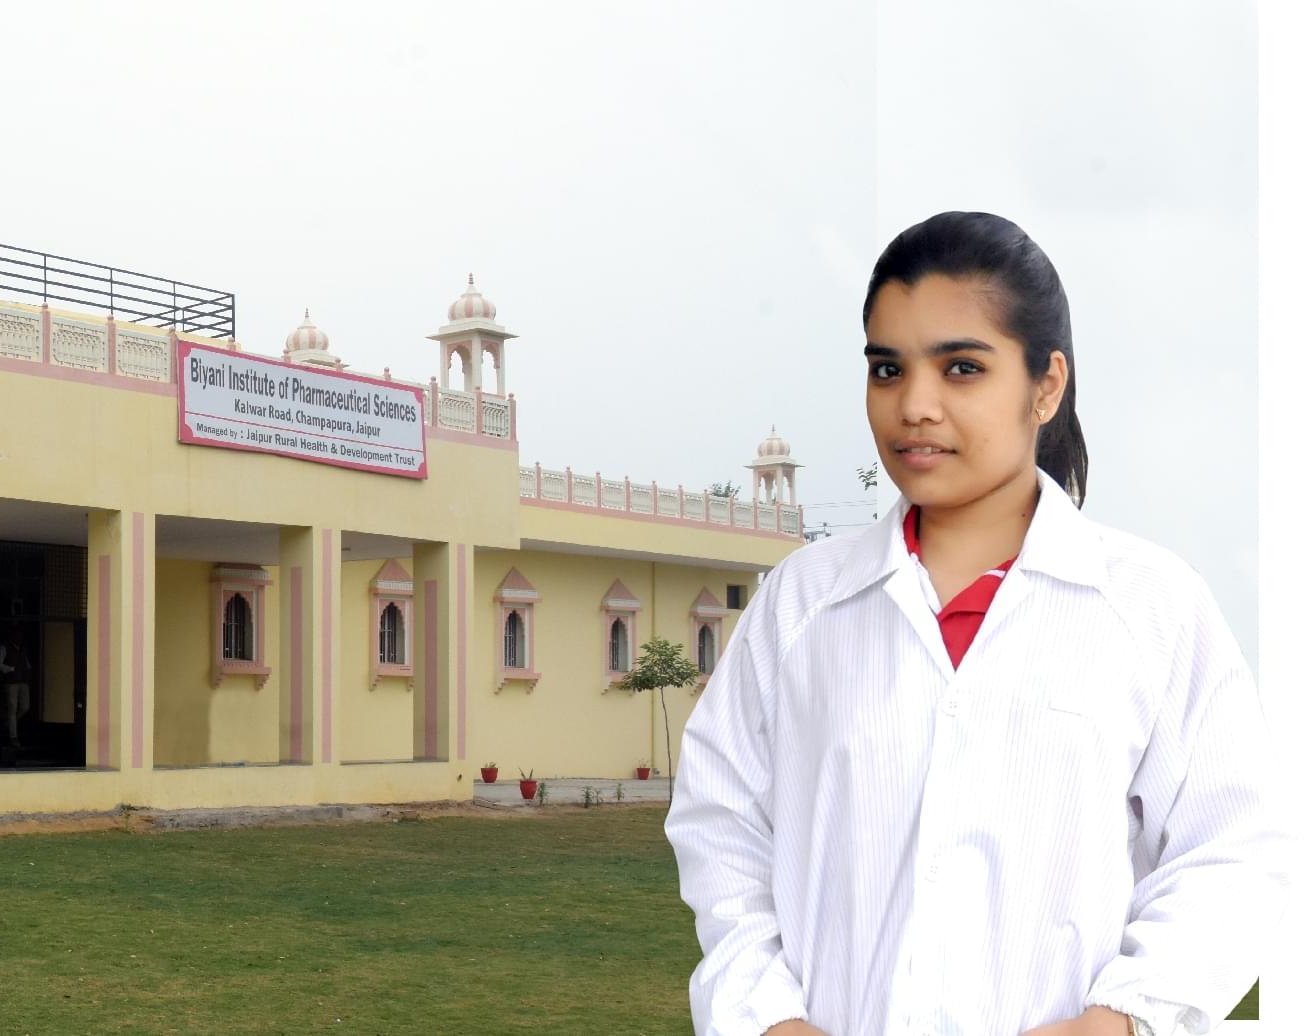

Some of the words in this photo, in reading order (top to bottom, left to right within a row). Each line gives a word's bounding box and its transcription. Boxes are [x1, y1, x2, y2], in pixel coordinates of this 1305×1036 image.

[190, 357, 225, 390] Biyani
[229, 365, 275, 396] Institute
[279, 376, 289, 399] of
[292, 378, 371, 415] Pharmaceutical
[373, 394, 417, 423] Sciences
[234, 399, 267, 418] Kalwar
[269, 408, 294, 424] Road,
[296, 410, 354, 435] Champapura,
[356, 421, 381, 439] Jaipur
[196, 423, 228, 437] Managed
[229, 428, 238, 440] by
[247, 429, 272, 445] Jaipur
[275, 434, 298, 448] Rural
[300, 437, 328, 454] Health
[331, 444, 338, 454] &
[340, 445, 393, 463] Development
[395, 451, 416, 466] Trust
